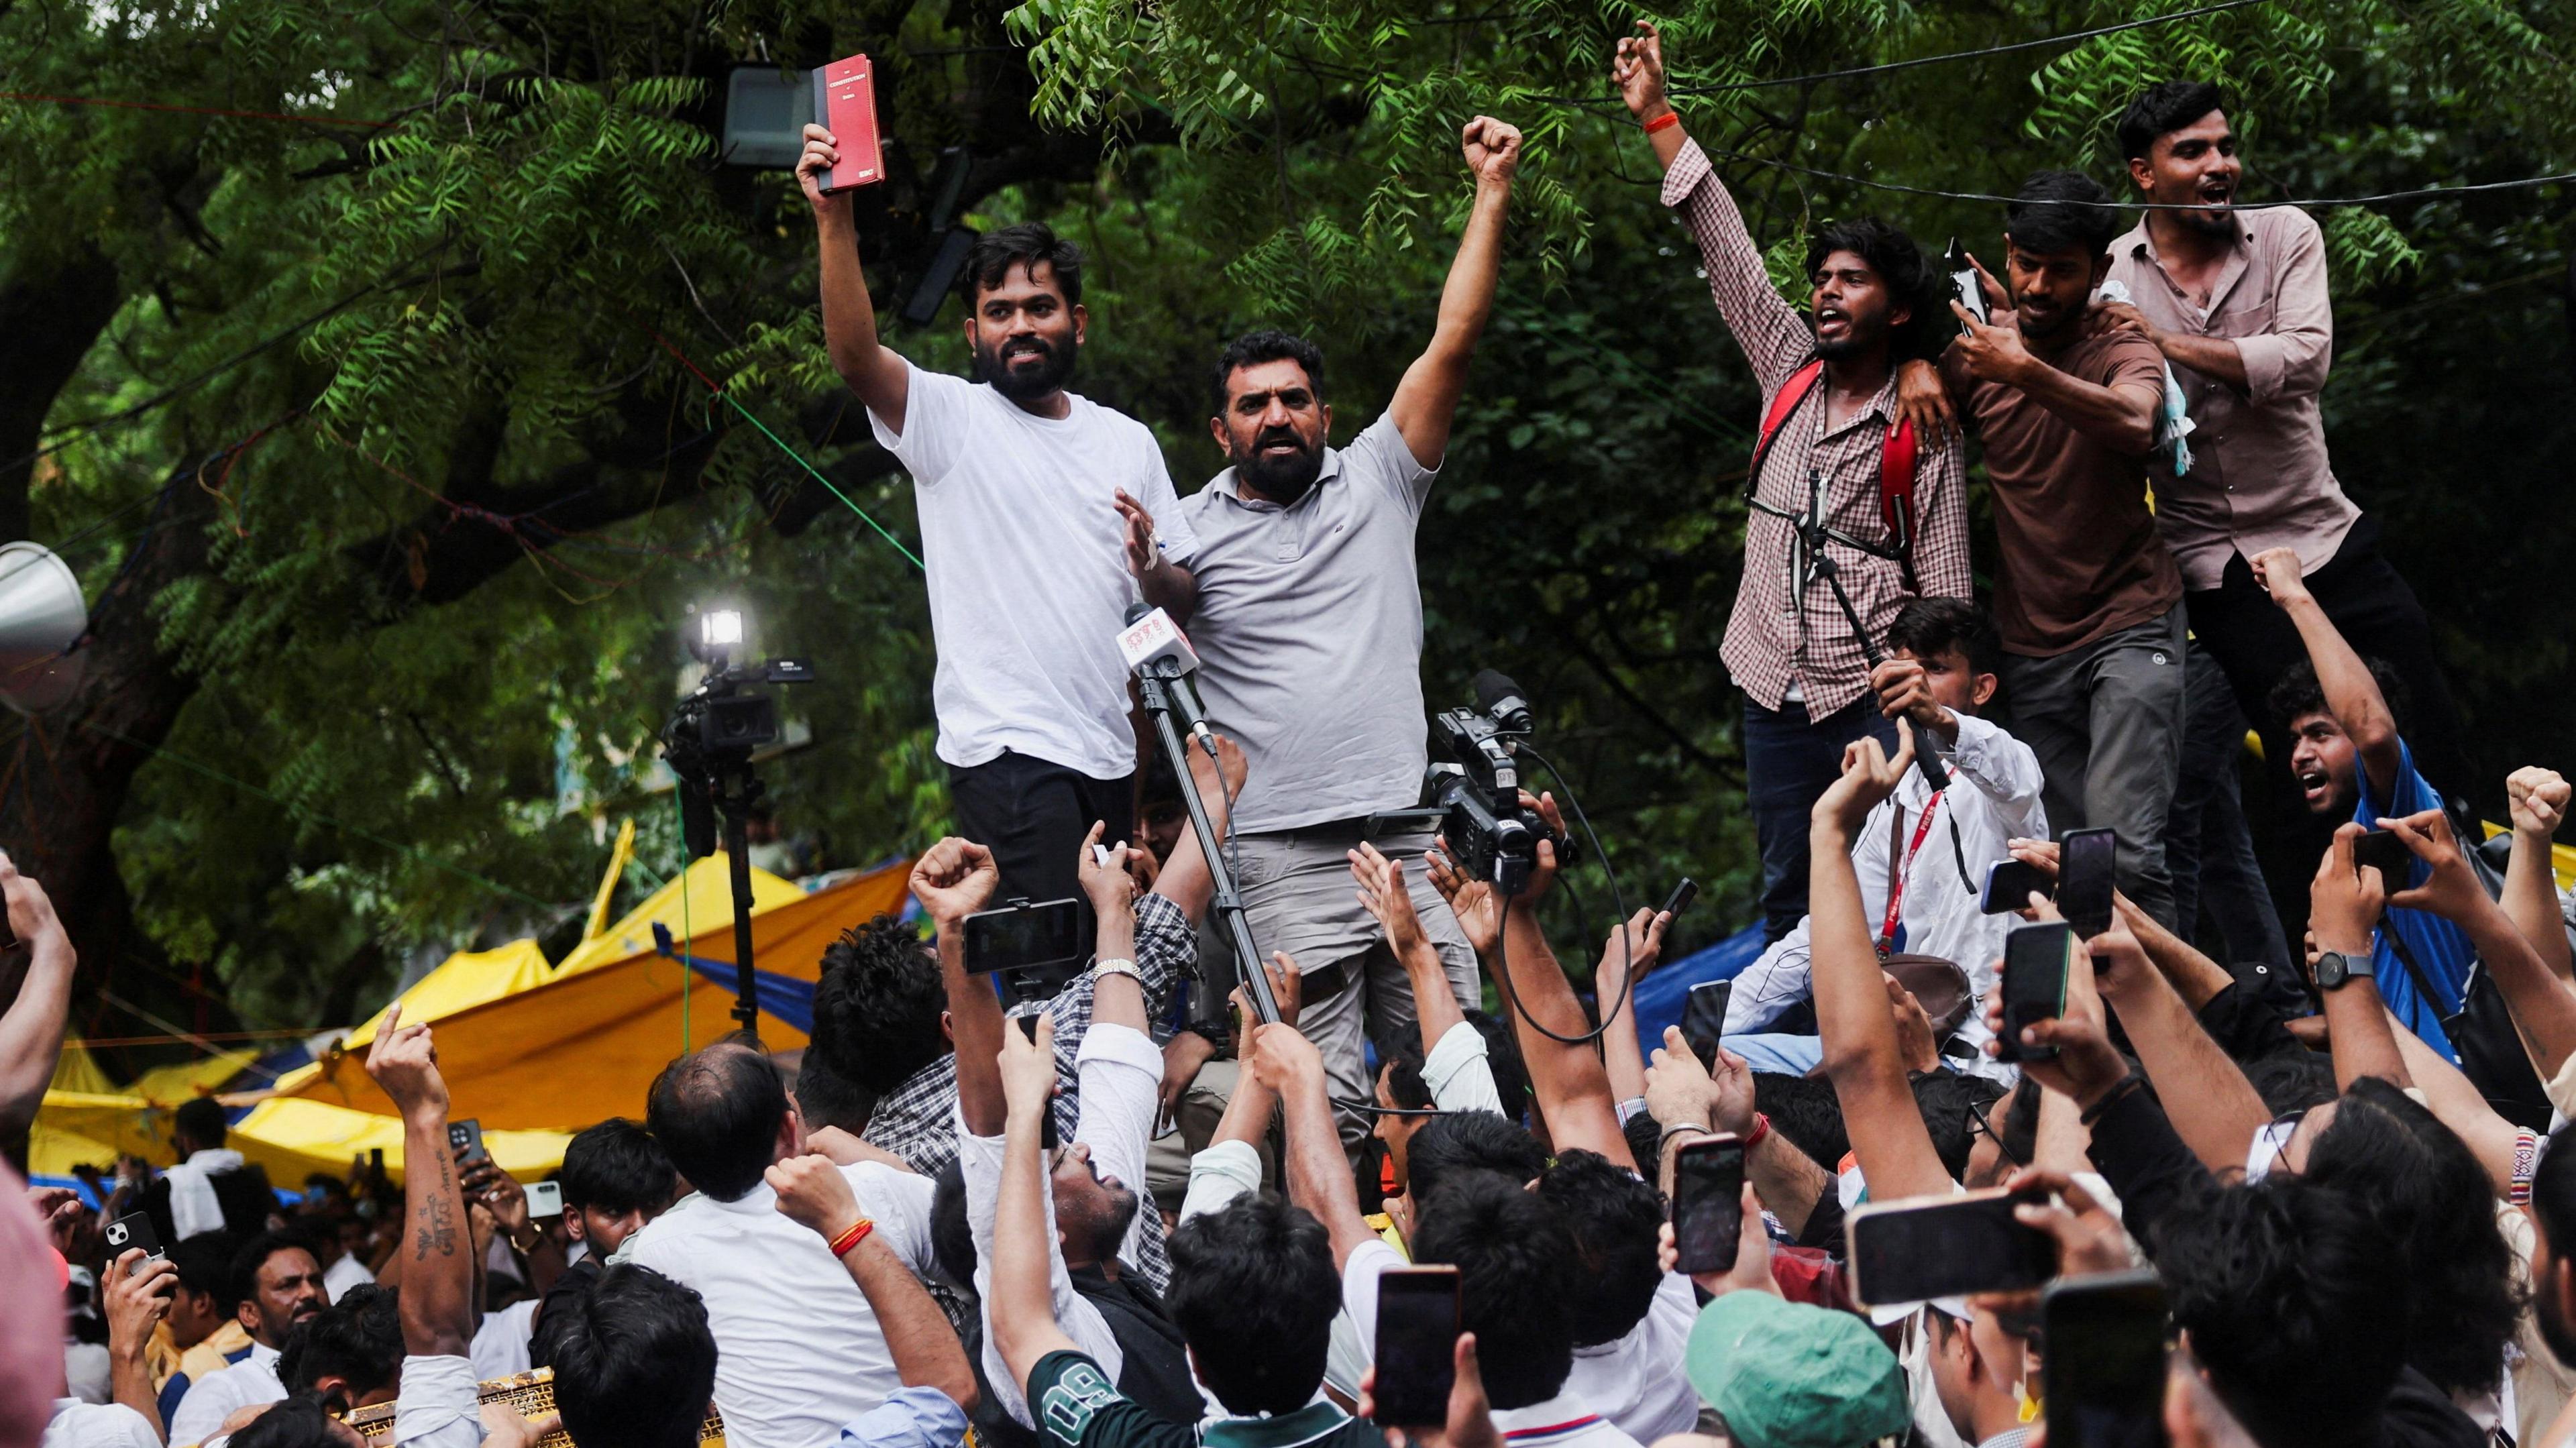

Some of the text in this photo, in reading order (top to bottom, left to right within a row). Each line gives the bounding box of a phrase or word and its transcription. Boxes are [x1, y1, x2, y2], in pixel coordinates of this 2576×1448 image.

[829, 73, 866, 88] CONSTITUTION
[1919, 805, 1935, 831] PRESS
[1888, 894, 1900, 922] PRESS
